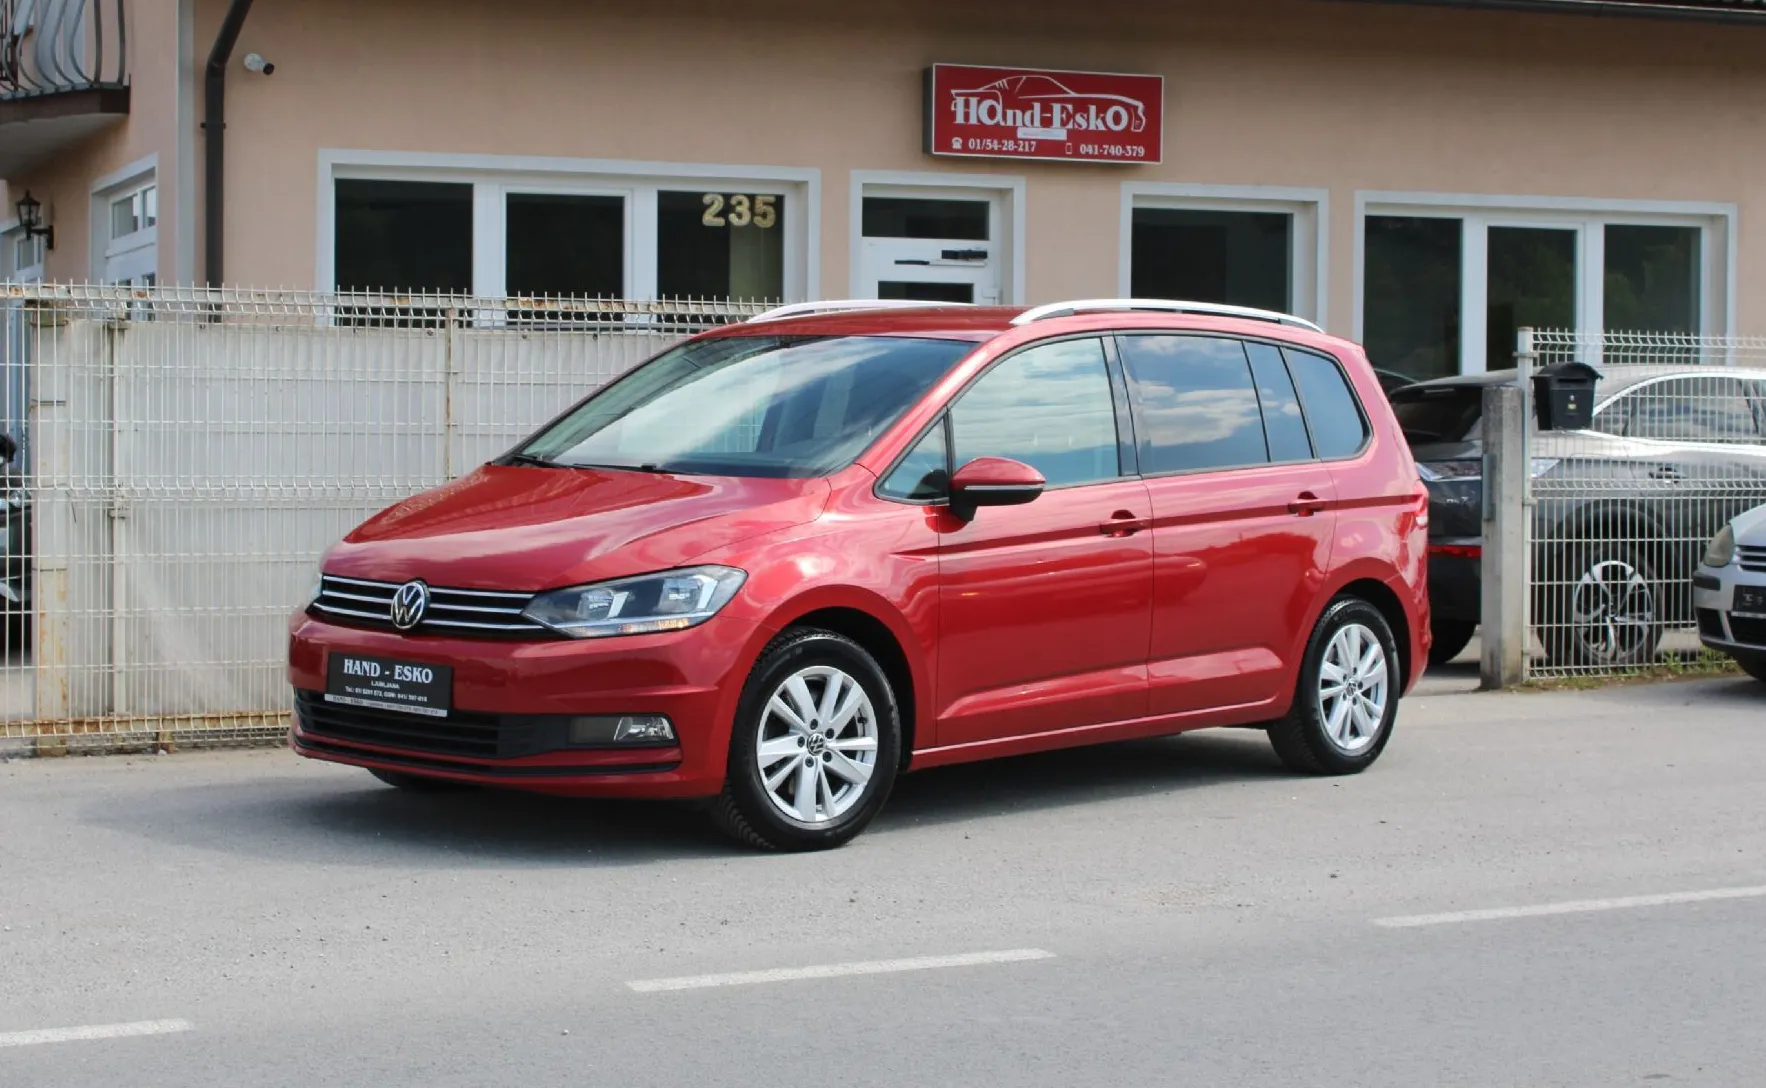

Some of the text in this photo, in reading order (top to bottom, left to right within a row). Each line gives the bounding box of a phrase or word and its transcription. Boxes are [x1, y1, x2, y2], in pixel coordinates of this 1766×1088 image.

[968, 139, 1037, 153] 01/54-28-217
[1080, 144, 1145, 158] 041-740-379
[701, 192, 777, 229] 235
[343, 658, 381, 678] HAND
[394, 665, 433, 684] ESKO
